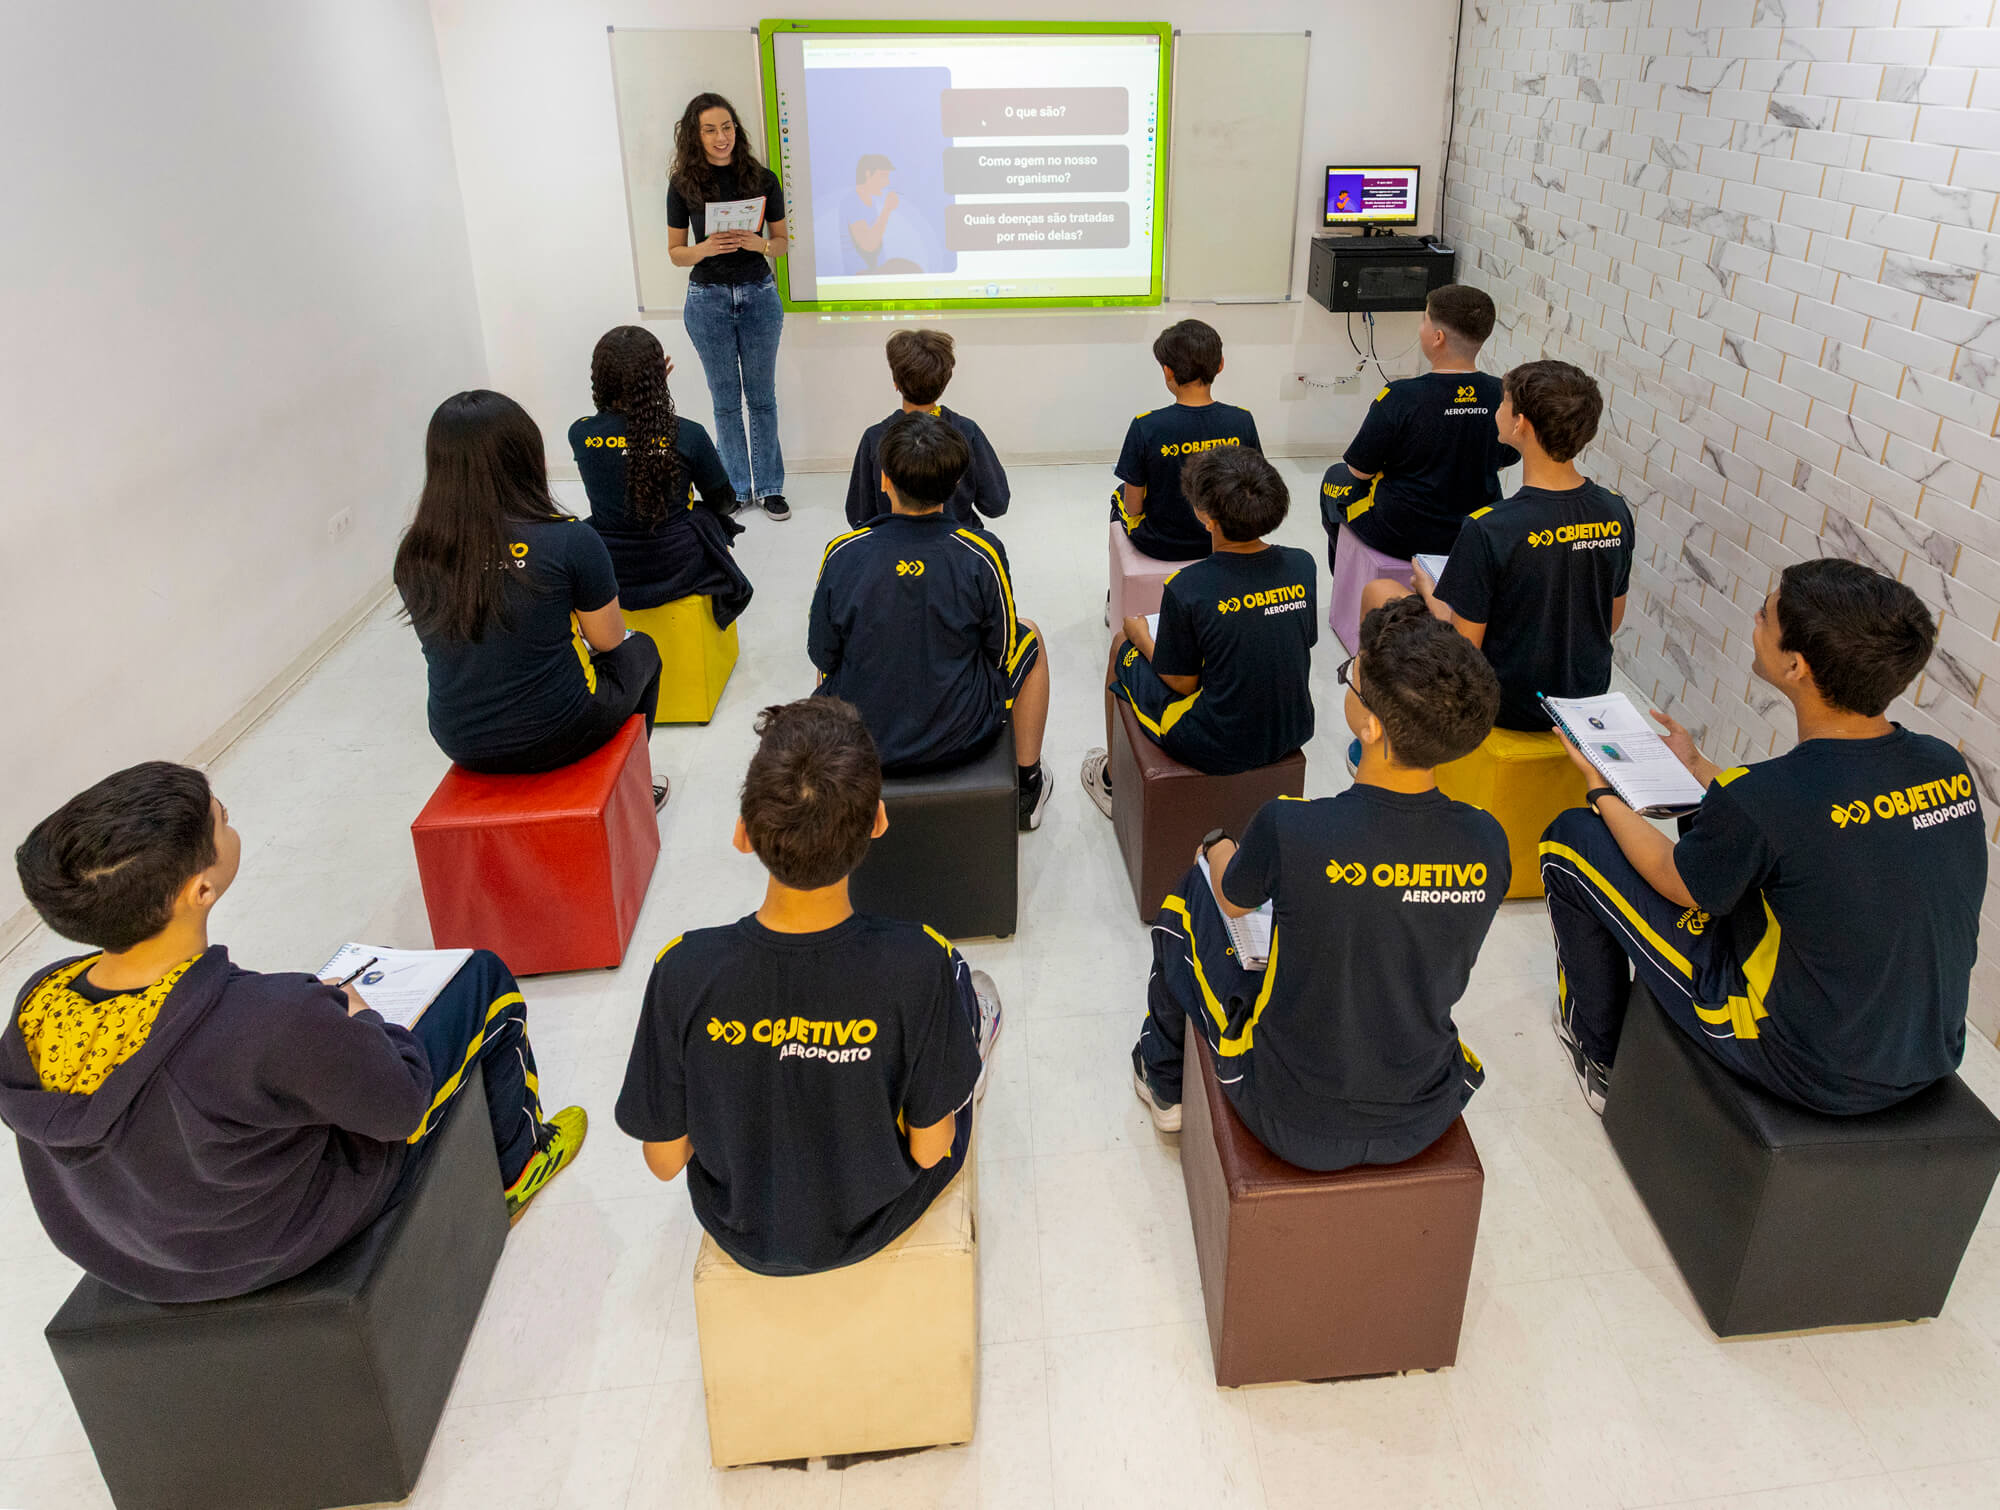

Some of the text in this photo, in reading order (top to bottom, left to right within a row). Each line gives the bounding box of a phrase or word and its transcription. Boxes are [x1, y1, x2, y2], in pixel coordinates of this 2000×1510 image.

[1004, 105, 1067, 119] O que são?
[978, 155, 1098, 168] Como agem no nosso
[1006, 172, 1071, 185] organismo?
[963, 212, 1115, 226] Quais doenças são tratadas
[996, 229, 1084, 244] por meio delas?
[1555, 520, 1622, 543] OBJETIVO
[1571, 537, 1622, 552] AEROPORTO
[1242, 583, 1306, 609] OBJETIVO
[1264, 600, 1307, 616] AEROPORTO
[1873, 773, 1972, 819] OBJETIVO
[1912, 799, 1977, 830] AEROPORTO
[1372, 862, 1488, 888] OBJETIVO
[1402, 889, 1487, 904] AEROPORTO
[752, 1016, 878, 1048] OBJETIVO
[779, 1043, 872, 1064] AEROPORTO
